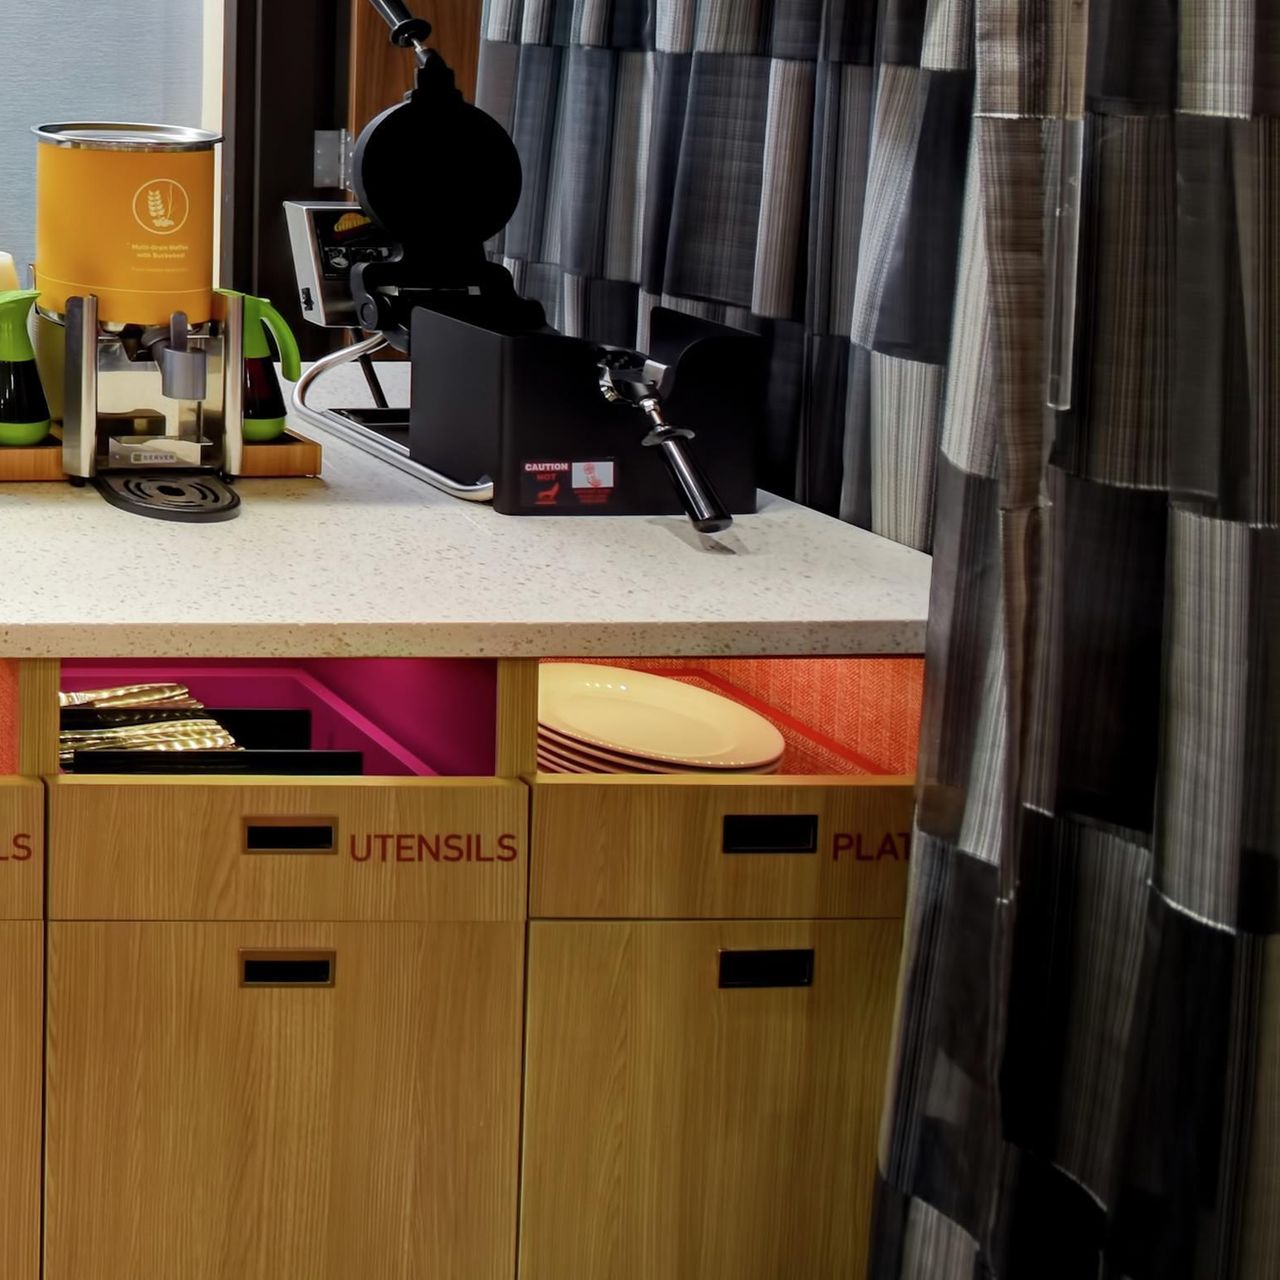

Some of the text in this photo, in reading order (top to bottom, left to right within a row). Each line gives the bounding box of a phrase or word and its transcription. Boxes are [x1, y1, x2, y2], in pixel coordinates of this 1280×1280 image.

[524, 462, 568, 471] CAUTION
[536, 473, 557, 481] HOT
[350, 833, 518, 863] UTENSILS
[832, 832, 911, 862] PLAT
